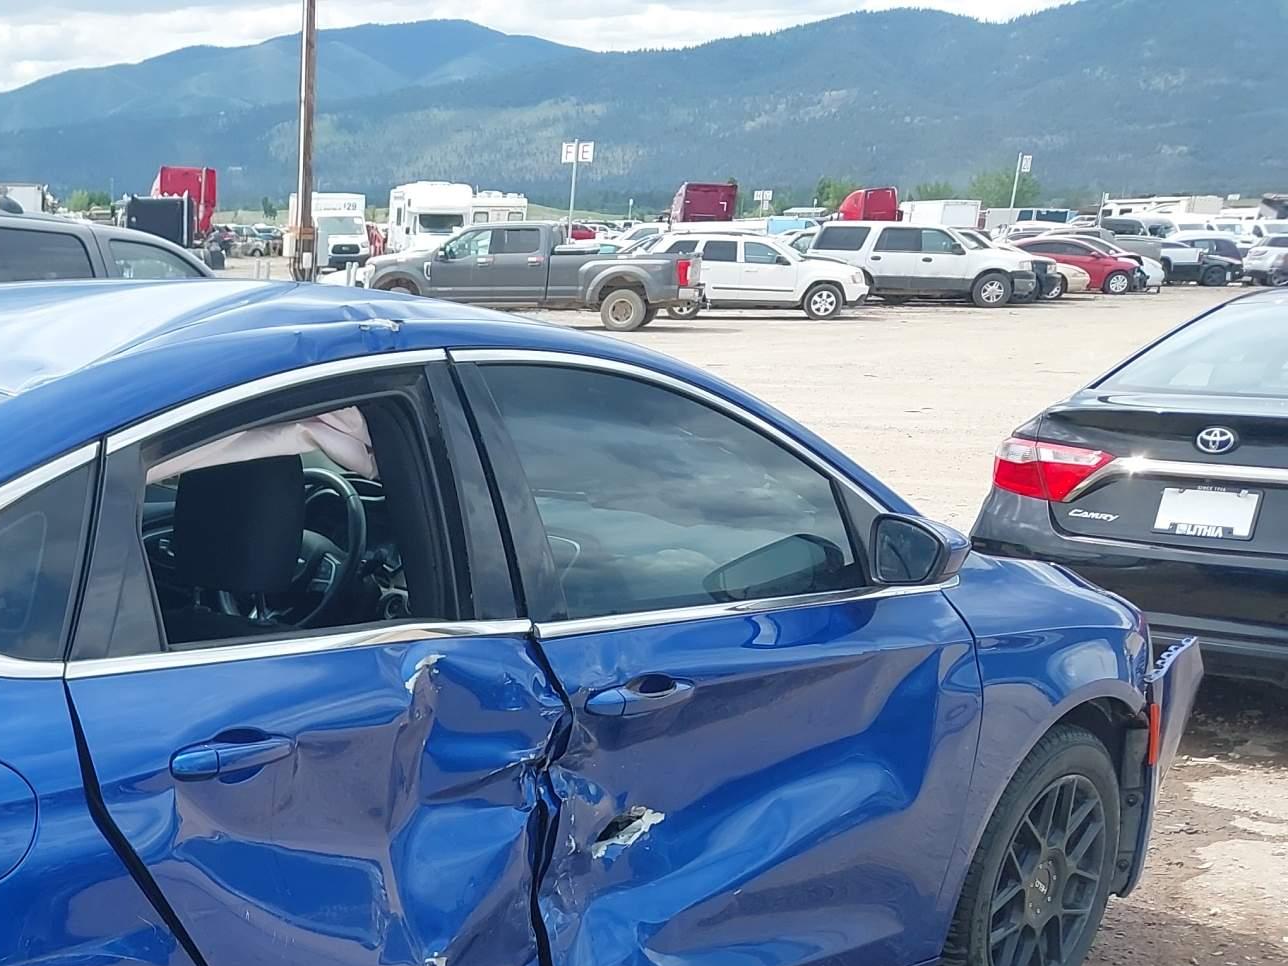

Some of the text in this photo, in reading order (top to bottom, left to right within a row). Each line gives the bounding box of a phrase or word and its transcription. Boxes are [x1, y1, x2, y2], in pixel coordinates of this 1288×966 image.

[566, 144, 573, 160] F
[582, 144, 590, 160] E
[1187, 524, 1223, 538] LITHIA
